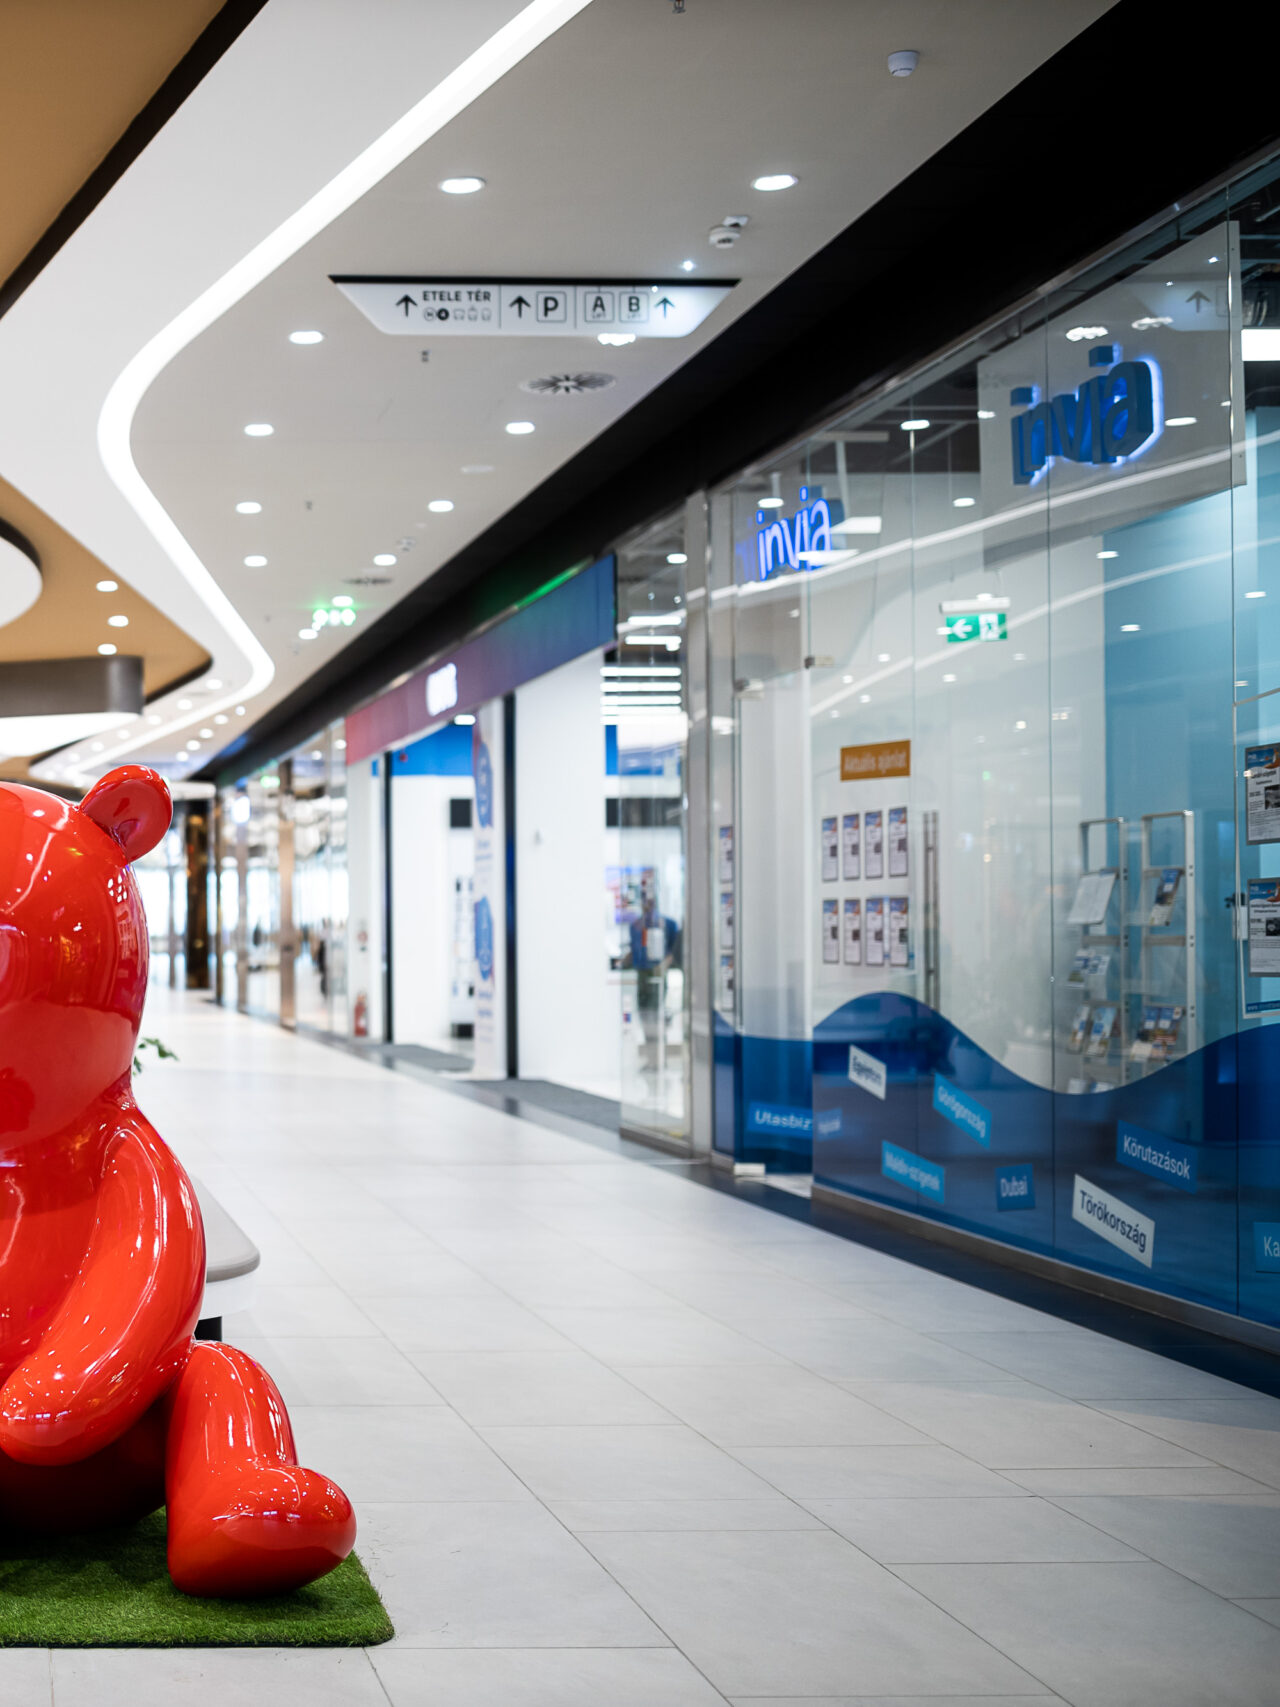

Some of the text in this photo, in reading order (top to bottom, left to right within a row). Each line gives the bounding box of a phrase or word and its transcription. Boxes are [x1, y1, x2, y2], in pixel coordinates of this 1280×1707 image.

[423, 288, 491, 302] ETELE TÉR
[591, 295, 606, 313] A
[628, 295, 641, 313] B
[543, 296, 559, 317] P
[1010, 343, 1162, 486] invia
[756, 485, 833, 580] invia
[1123, 1135, 1191, 1180] Körutazások
[1000, 1176, 1028, 1198] Dubai
[1080, 1190, 1147, 1254] Törökország
